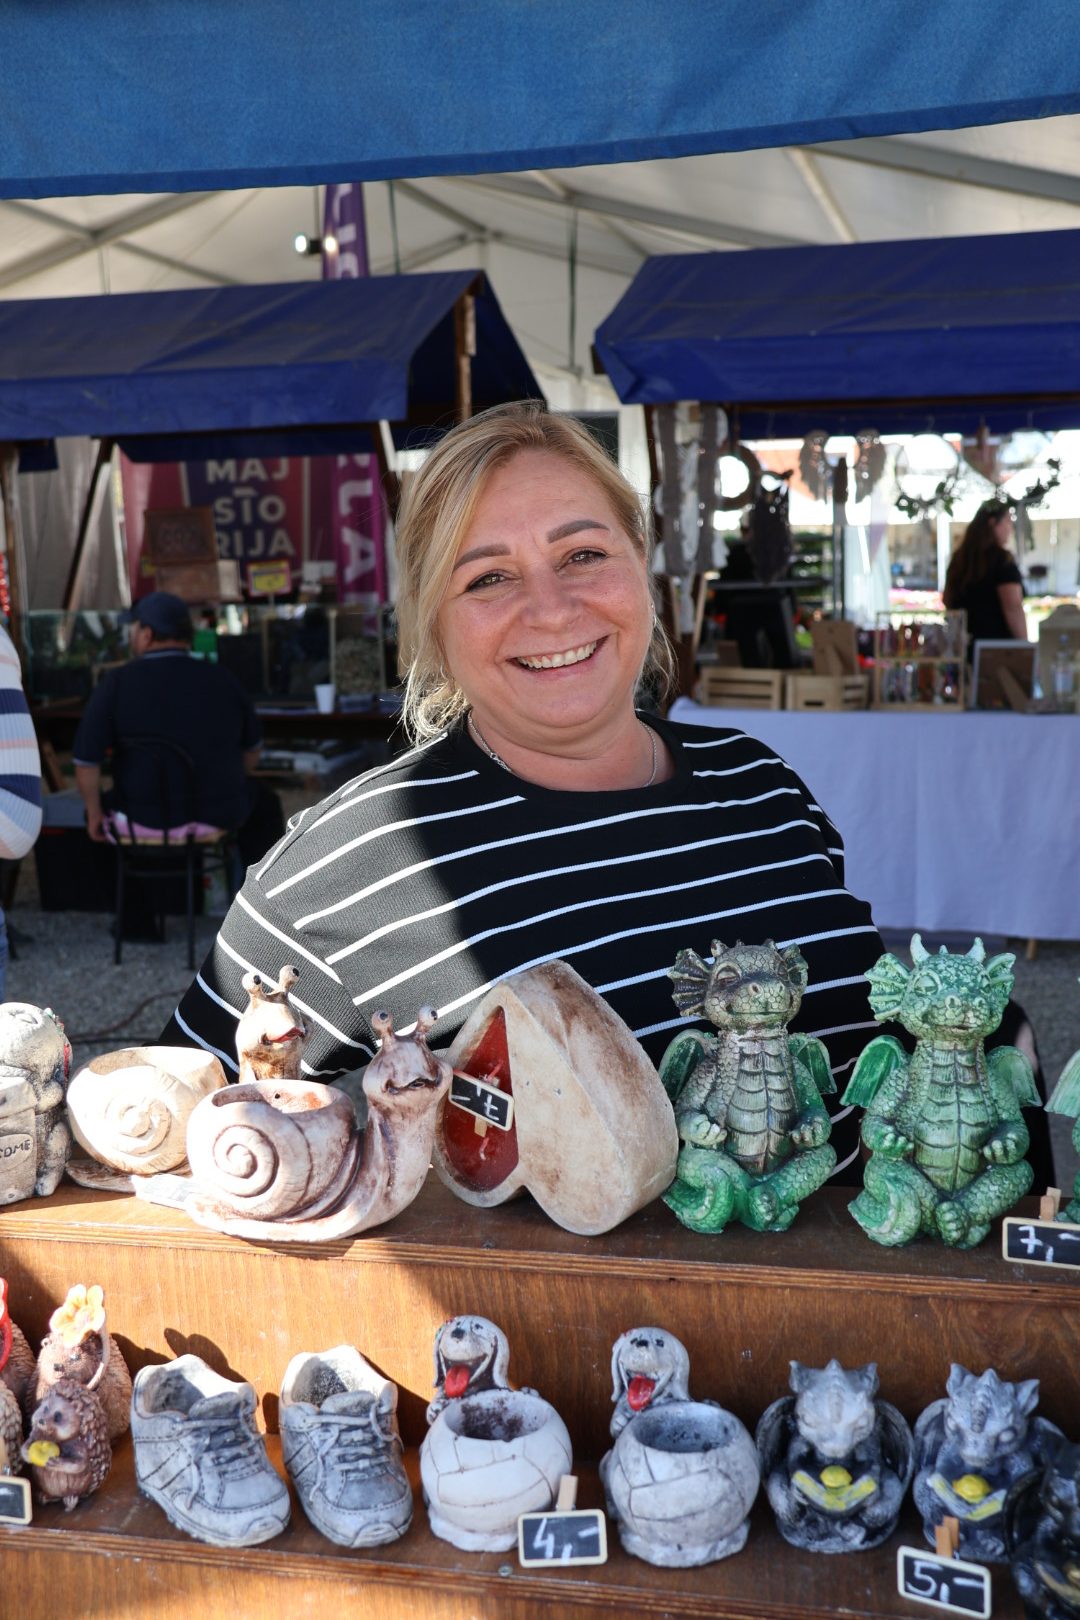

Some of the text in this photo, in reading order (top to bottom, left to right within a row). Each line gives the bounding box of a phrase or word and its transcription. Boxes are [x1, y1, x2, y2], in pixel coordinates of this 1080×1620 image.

[206, 457, 289, 484] MAJ
[214, 486, 286, 525] STO
[216, 528, 296, 557] RIJA
[0, 1139, 31, 1158] OME
